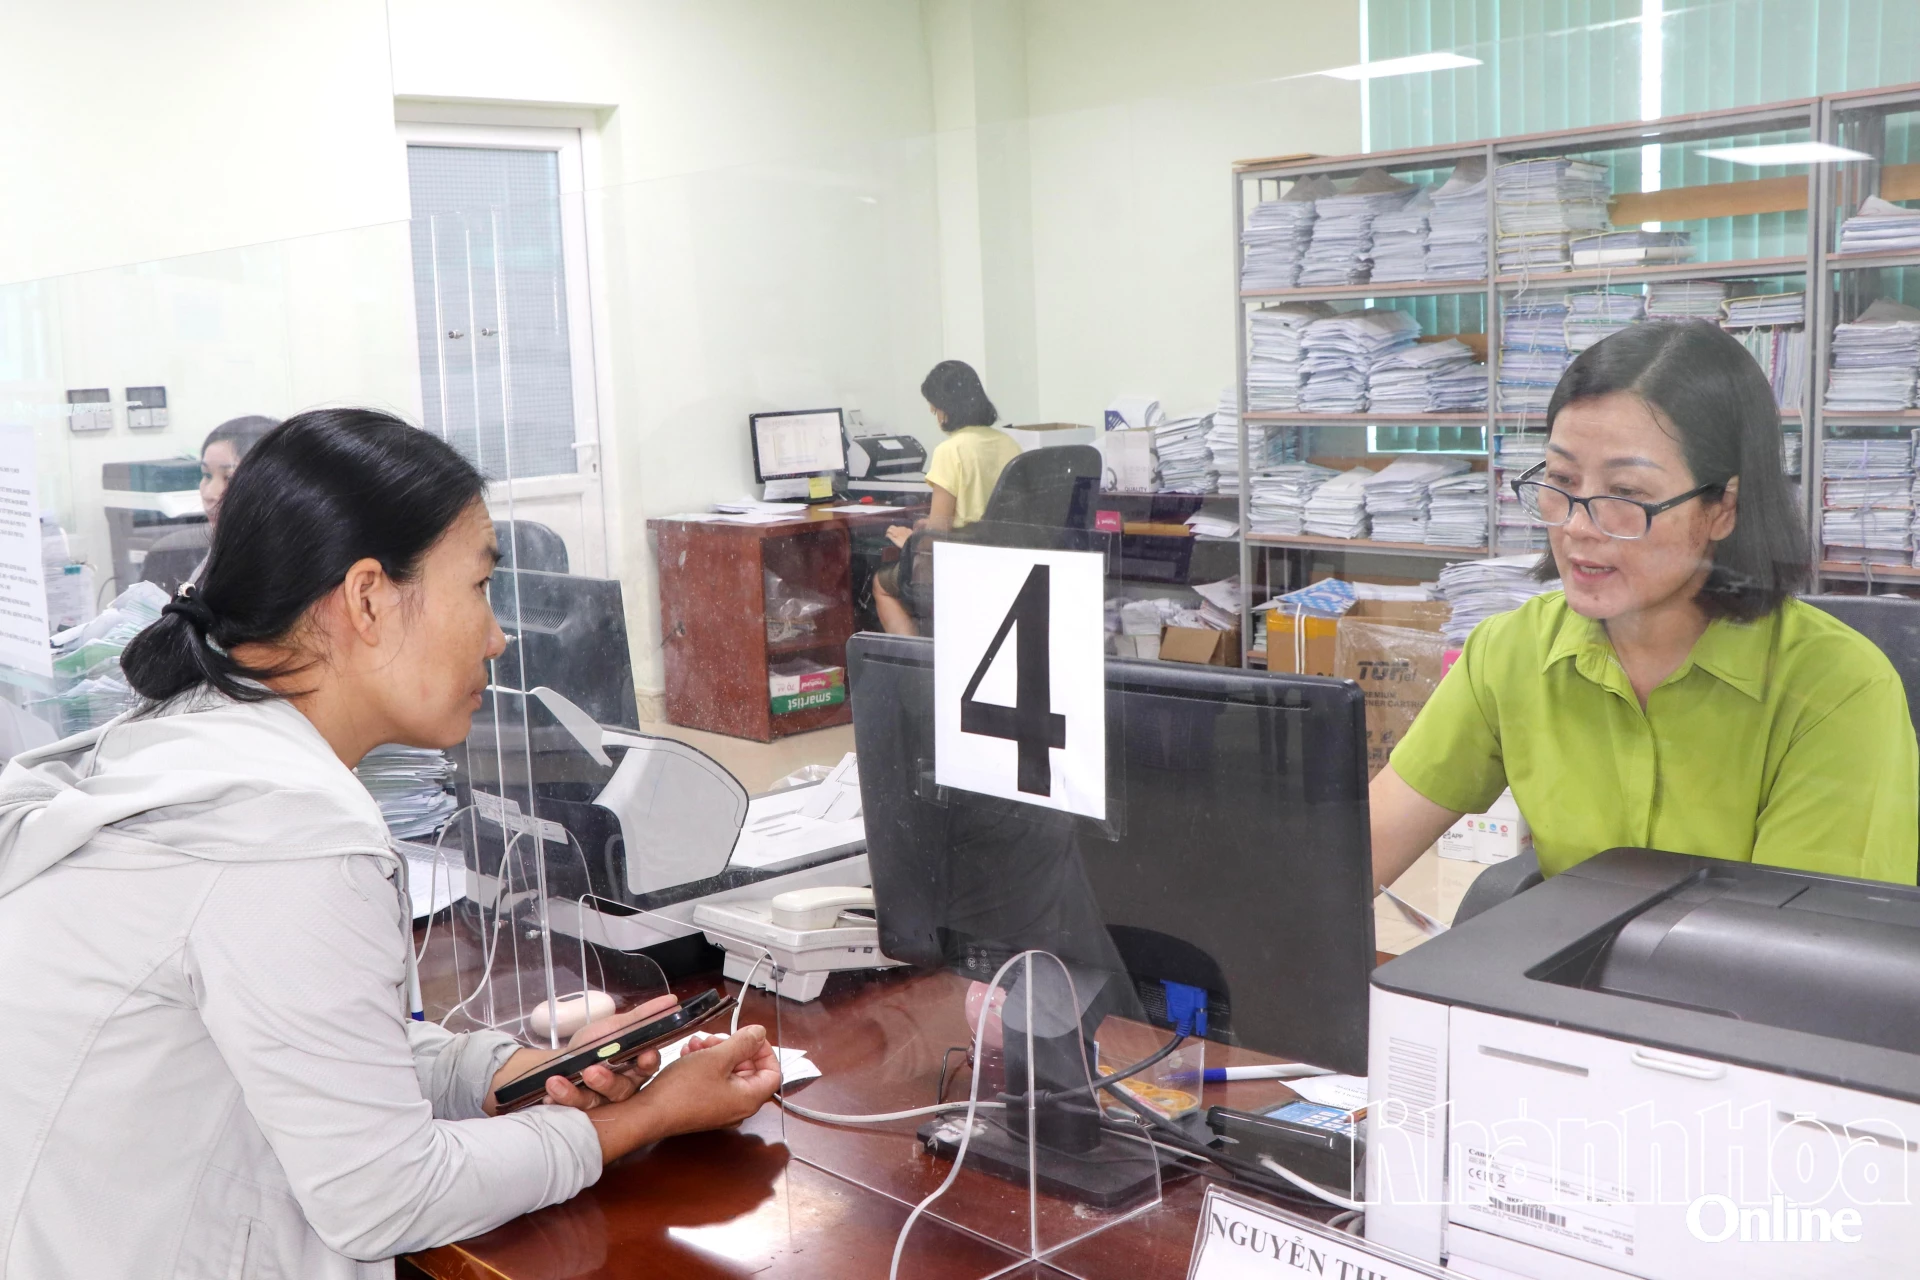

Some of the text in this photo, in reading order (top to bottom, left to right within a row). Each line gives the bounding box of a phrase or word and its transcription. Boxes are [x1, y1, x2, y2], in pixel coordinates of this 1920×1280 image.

[788, 692, 831, 710] smartist
[961, 564, 1066, 798] 4
[1210, 1212, 1388, 1280] NGUYỄN TH
